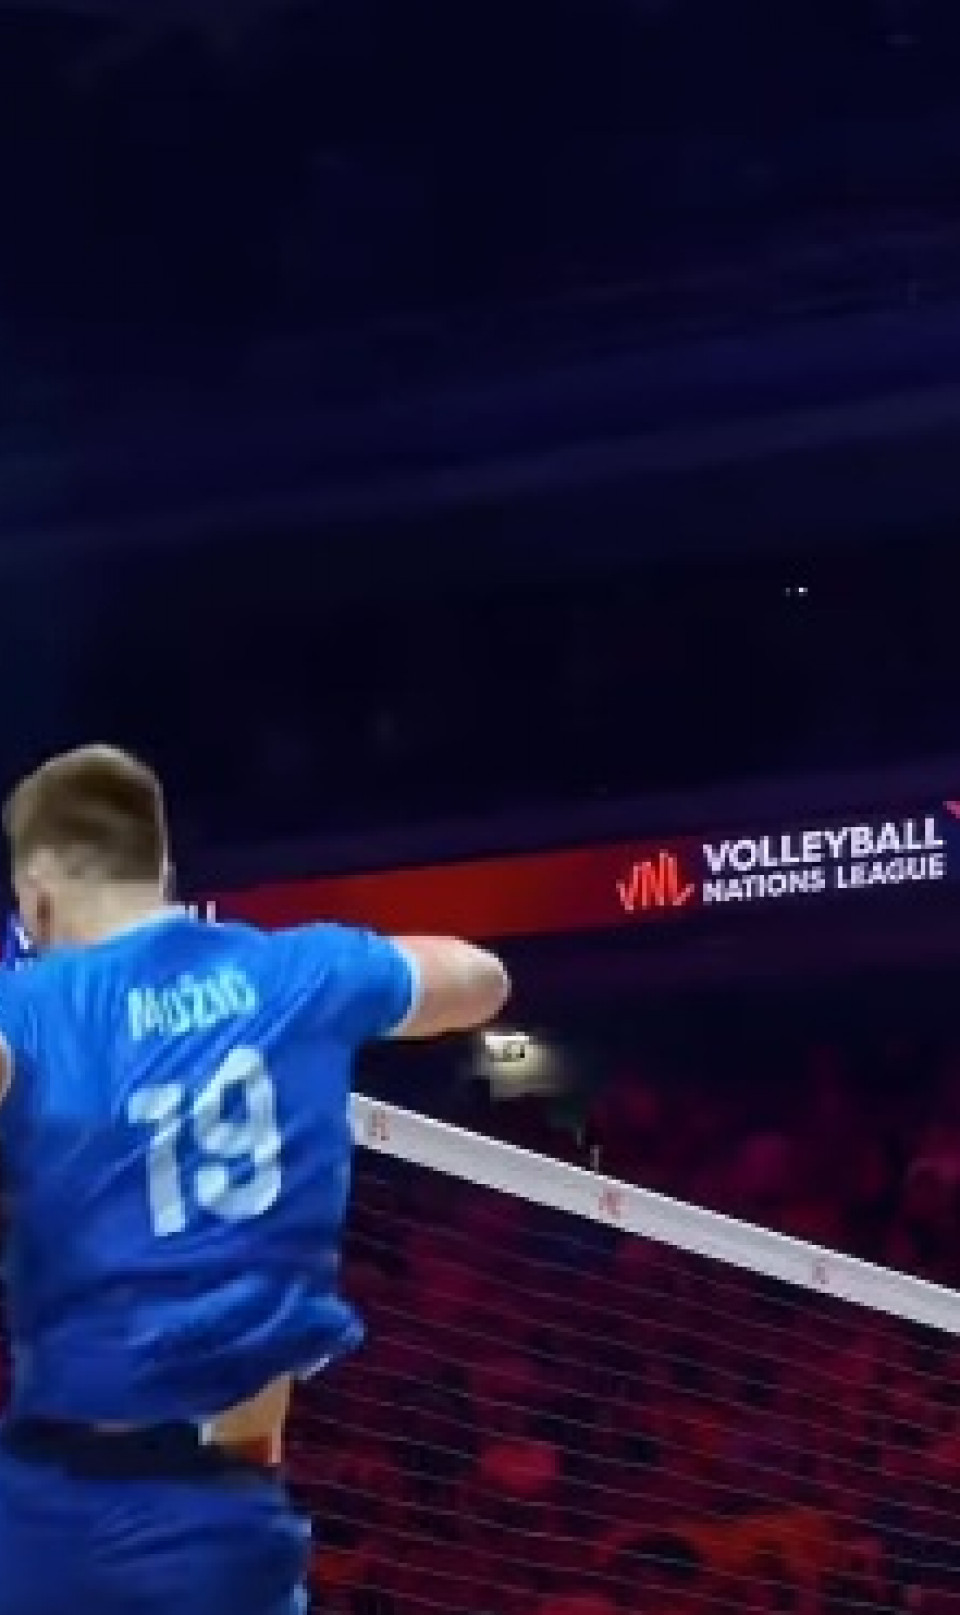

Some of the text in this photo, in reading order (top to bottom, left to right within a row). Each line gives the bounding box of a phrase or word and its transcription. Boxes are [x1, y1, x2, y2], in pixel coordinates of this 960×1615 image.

[703, 817, 945, 872] VOLLEYBALL
[703, 853, 945, 902] NATIONS LEAGUE
[127, 1046, 282, 1236] 19
